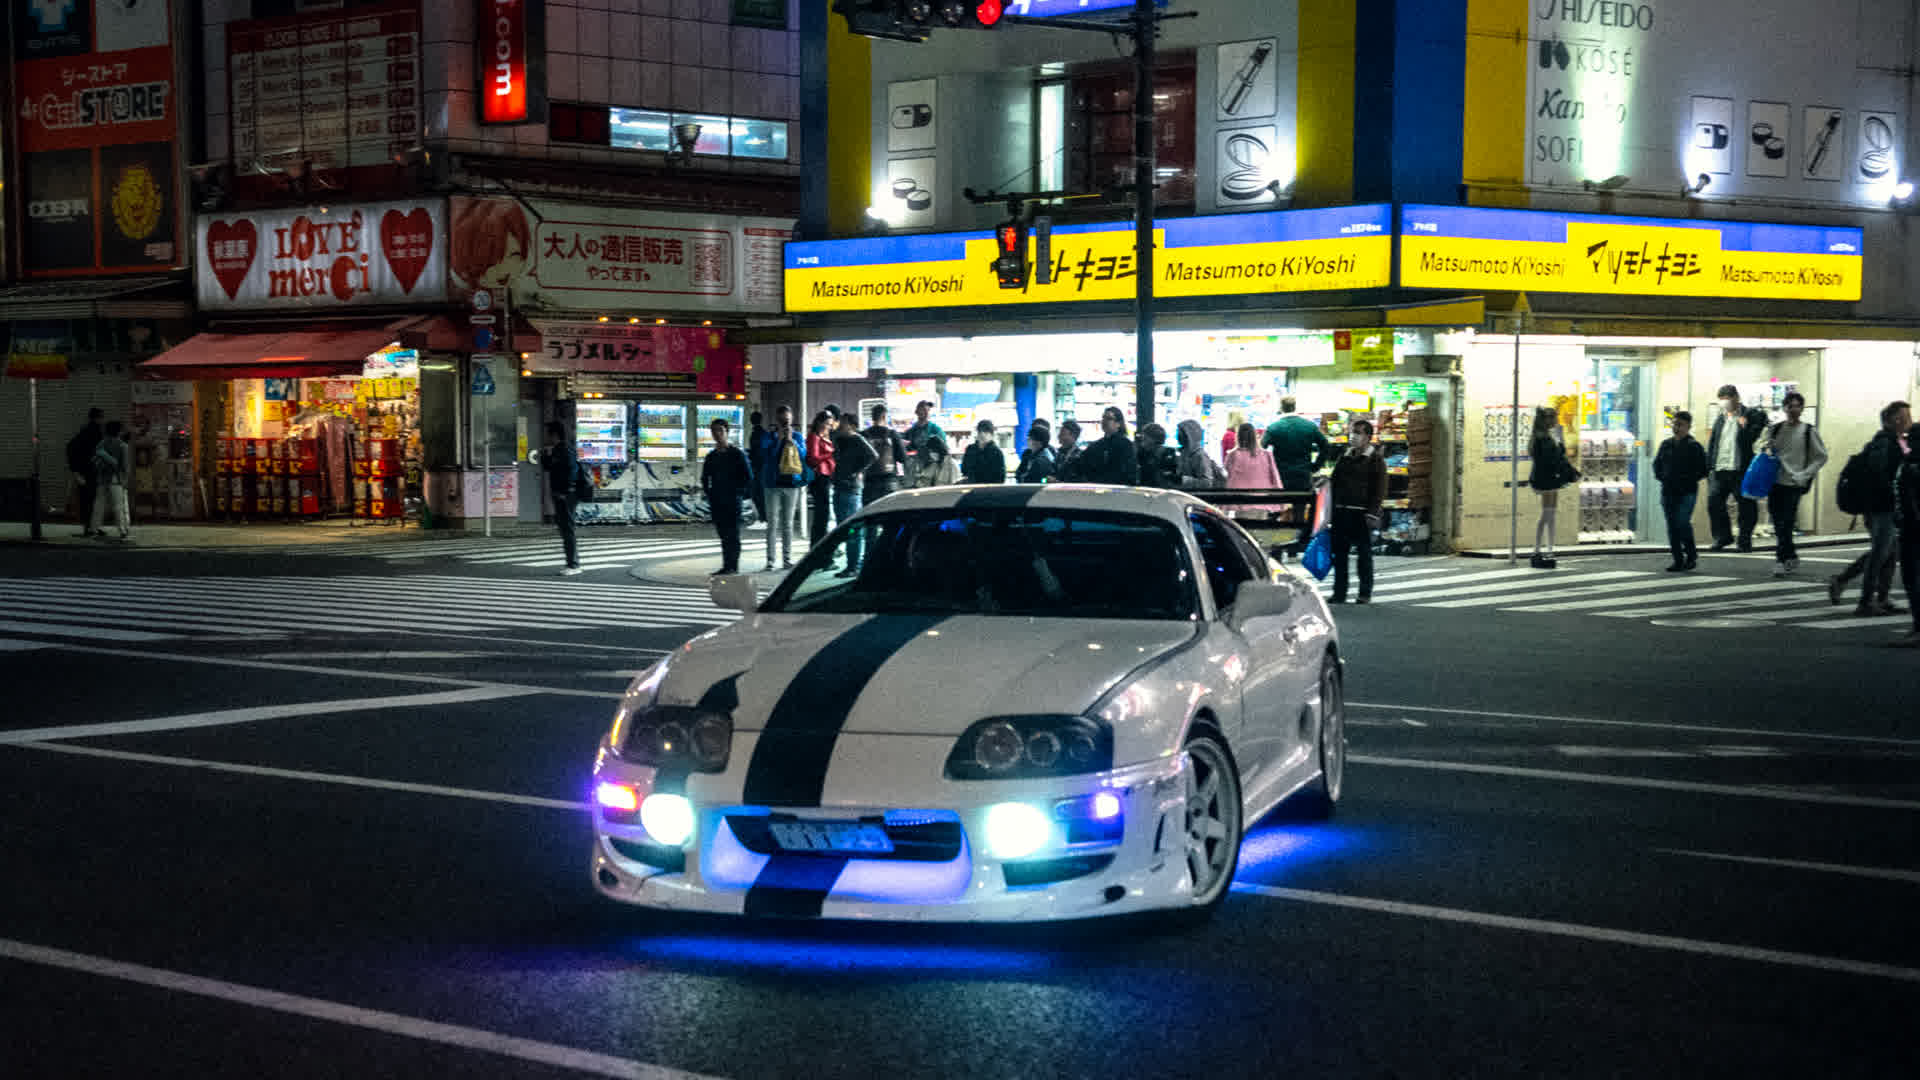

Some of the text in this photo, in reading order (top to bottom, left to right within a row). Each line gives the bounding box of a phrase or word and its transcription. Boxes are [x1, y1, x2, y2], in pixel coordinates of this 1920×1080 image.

[1537, 0, 1654, 31] SHISEIDO
[495, 0, 512, 96] .com
[544, 231, 684, 266] 大人の通信販売
[1165, 254, 1356, 282] Matsumoto KiYoshi
[1420, 252, 1566, 278] Matsumoto KiYoshi
[1721, 265, 1794, 286] Matsumoto
[811, 274, 965, 298] Matsumoto KiYoshi
[547, 337, 653, 361] ラブメルシー
